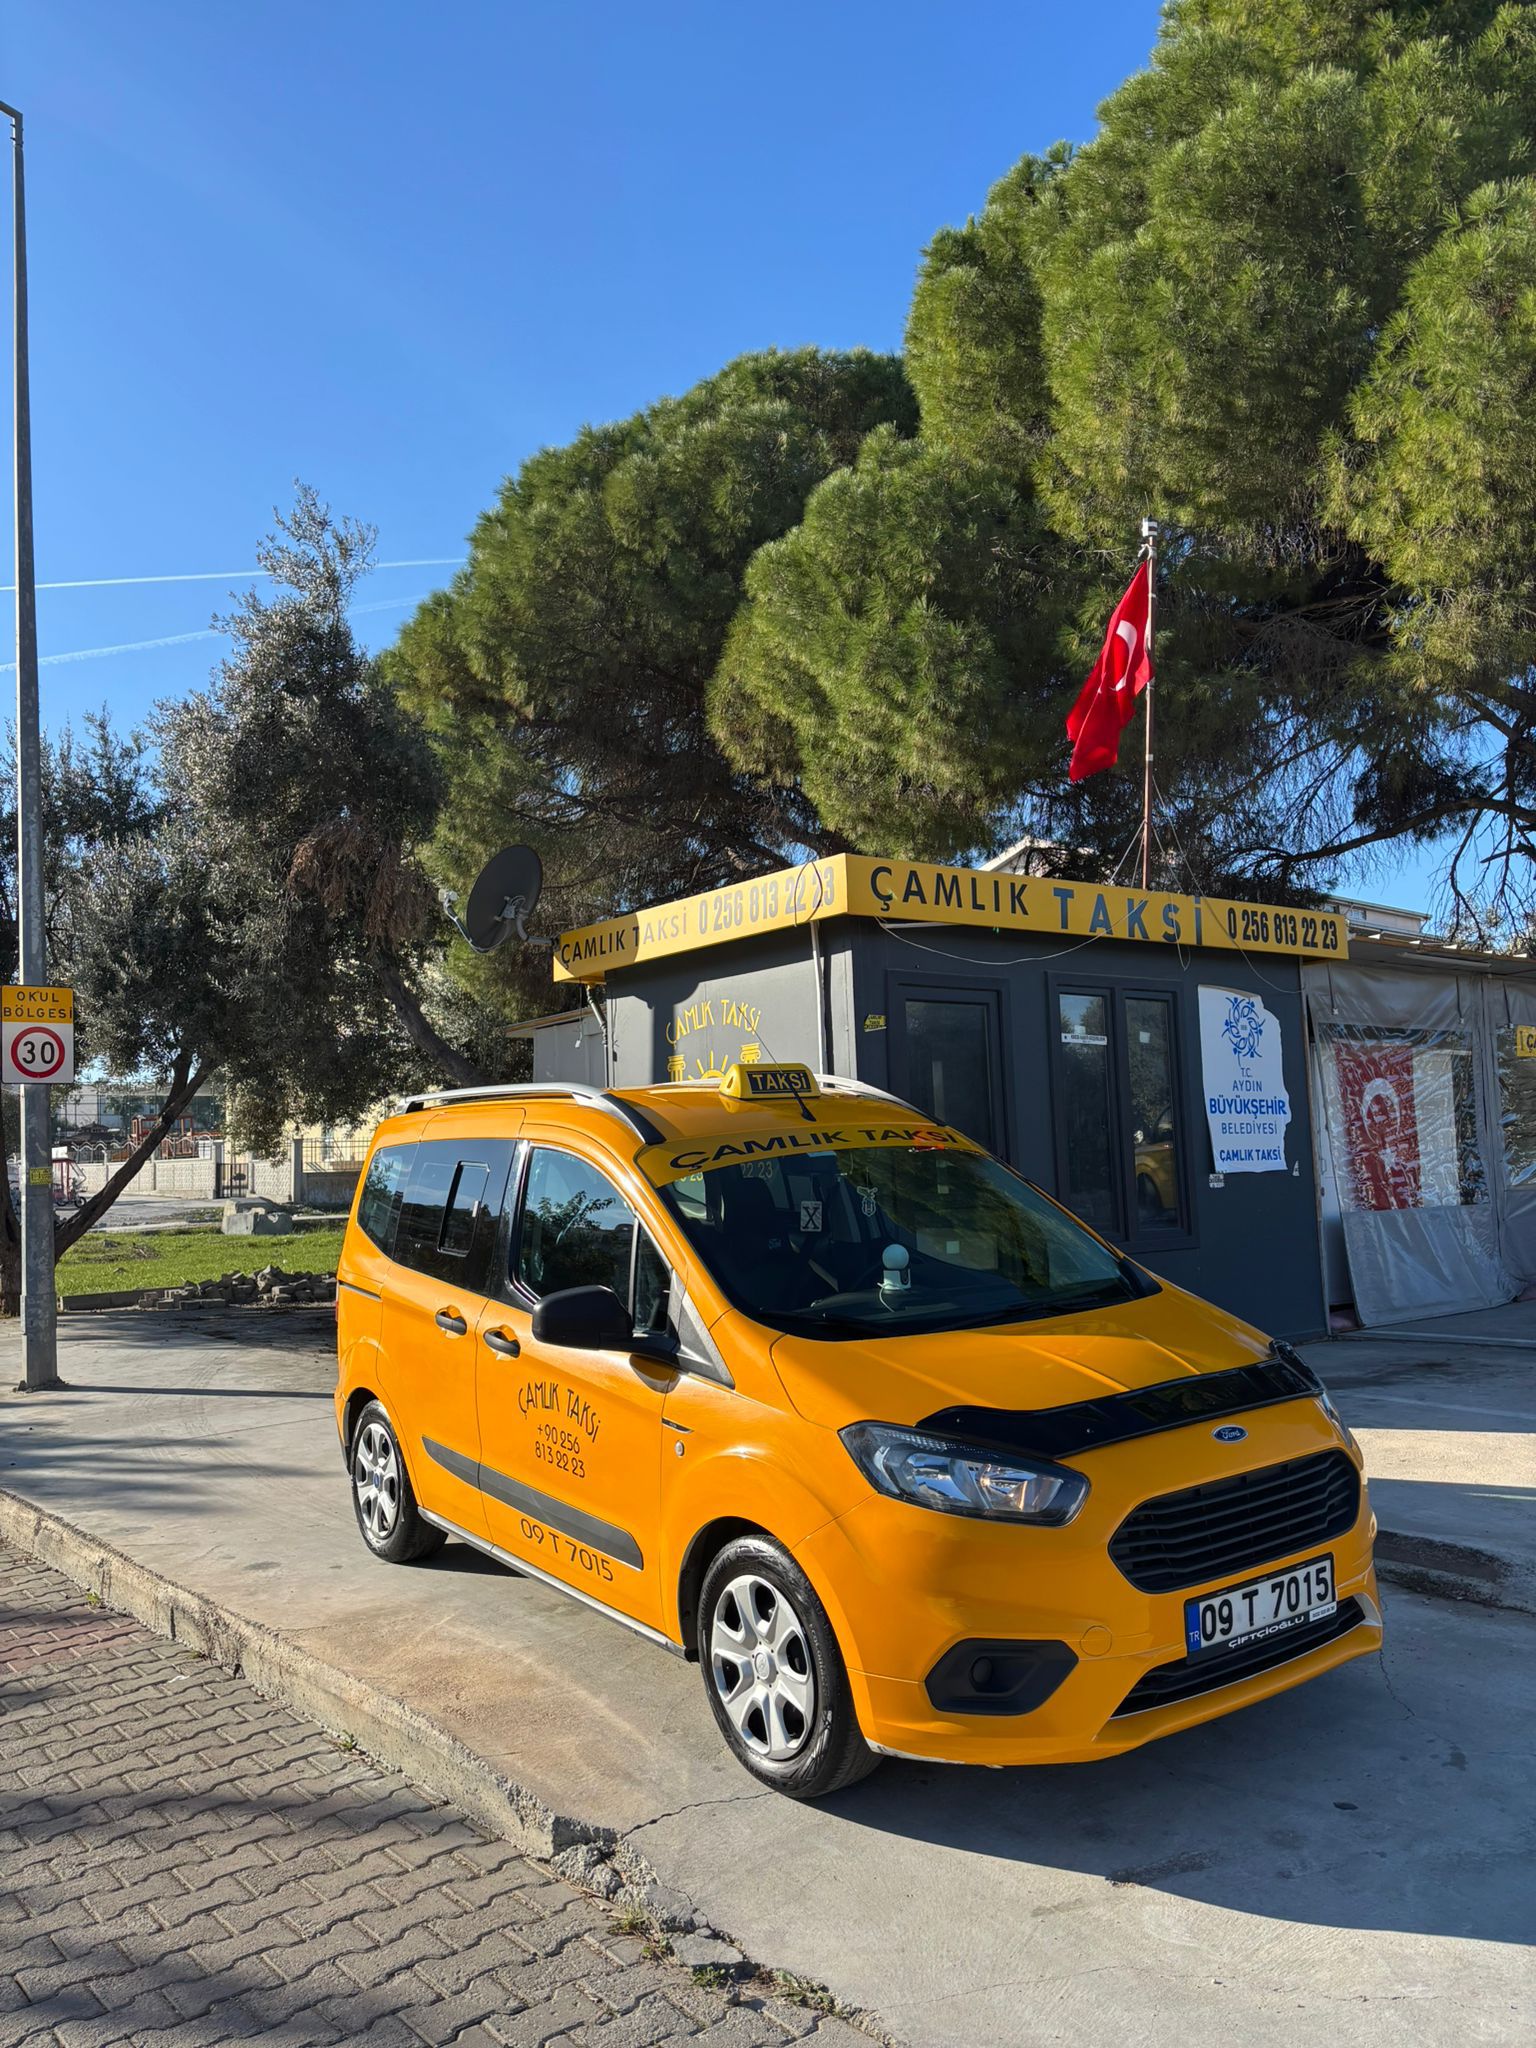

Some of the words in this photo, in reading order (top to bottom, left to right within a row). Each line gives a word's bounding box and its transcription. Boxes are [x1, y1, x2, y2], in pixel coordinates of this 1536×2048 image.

[561, 929, 626, 969] ÇAMLIK
[632, 907, 687, 947] TAKSİ
[699, 899, 708, 935] 0
[713, 890, 743, 931] 256
[749, 880, 779, 923] 813
[785, 874, 806, 914] 22
[812, 866, 835, 909] 23
[870, 866, 1029, 916] ÇAMLIK
[1052, 887, 1202, 945] TAKSİ
[1227, 907, 1237, 940] 0
[1242, 909, 1269, 943] 256
[1274, 913, 1297, 946] 813
[1301, 917, 1318, 948] 22
[1321, 919, 1338, 950] 23
[16, 991, 59, 1003] OKUL
[4, 1004, 73, 1019] BÖLGESİ
[666, 1000, 715, 1049] ÇAMLIK
[22, 1041, 55, 1064] 30
[1232, 1080, 1263, 1092] AYDIN
[1241, 1067, 1253, 1078] T.C.
[1209, 1095, 1287, 1119] BÜYÜKŞEHİR
[1221, 1120, 1278, 1134] BELEDİYESİ
[670, 1131, 851, 1172] ÇAMLIK
[1219, 1149, 1253, 1163] ÇAMLIK
[1256, 1146, 1282, 1161] TAKSİ
[518, 1381, 560, 1420] ÇAMLIK
[537, 1424, 558, 1445] +90
[560, 1430, 581, 1454] 256
[535, 1441, 554, 1464] 813
[556, 1450, 569, 1472] 22
[572, 1457, 586, 1479] 23
[520, 1518, 545, 1545] 09
[548, 1532, 559, 1553] T
[565, 1540, 614, 1582] 7015
[1201, 1599, 1233, 1641] 09
[1242, 1589, 1259, 1627] T
[1271, 1565, 1329, 1619] 7015
[1189, 1630, 1200, 1643] TR
